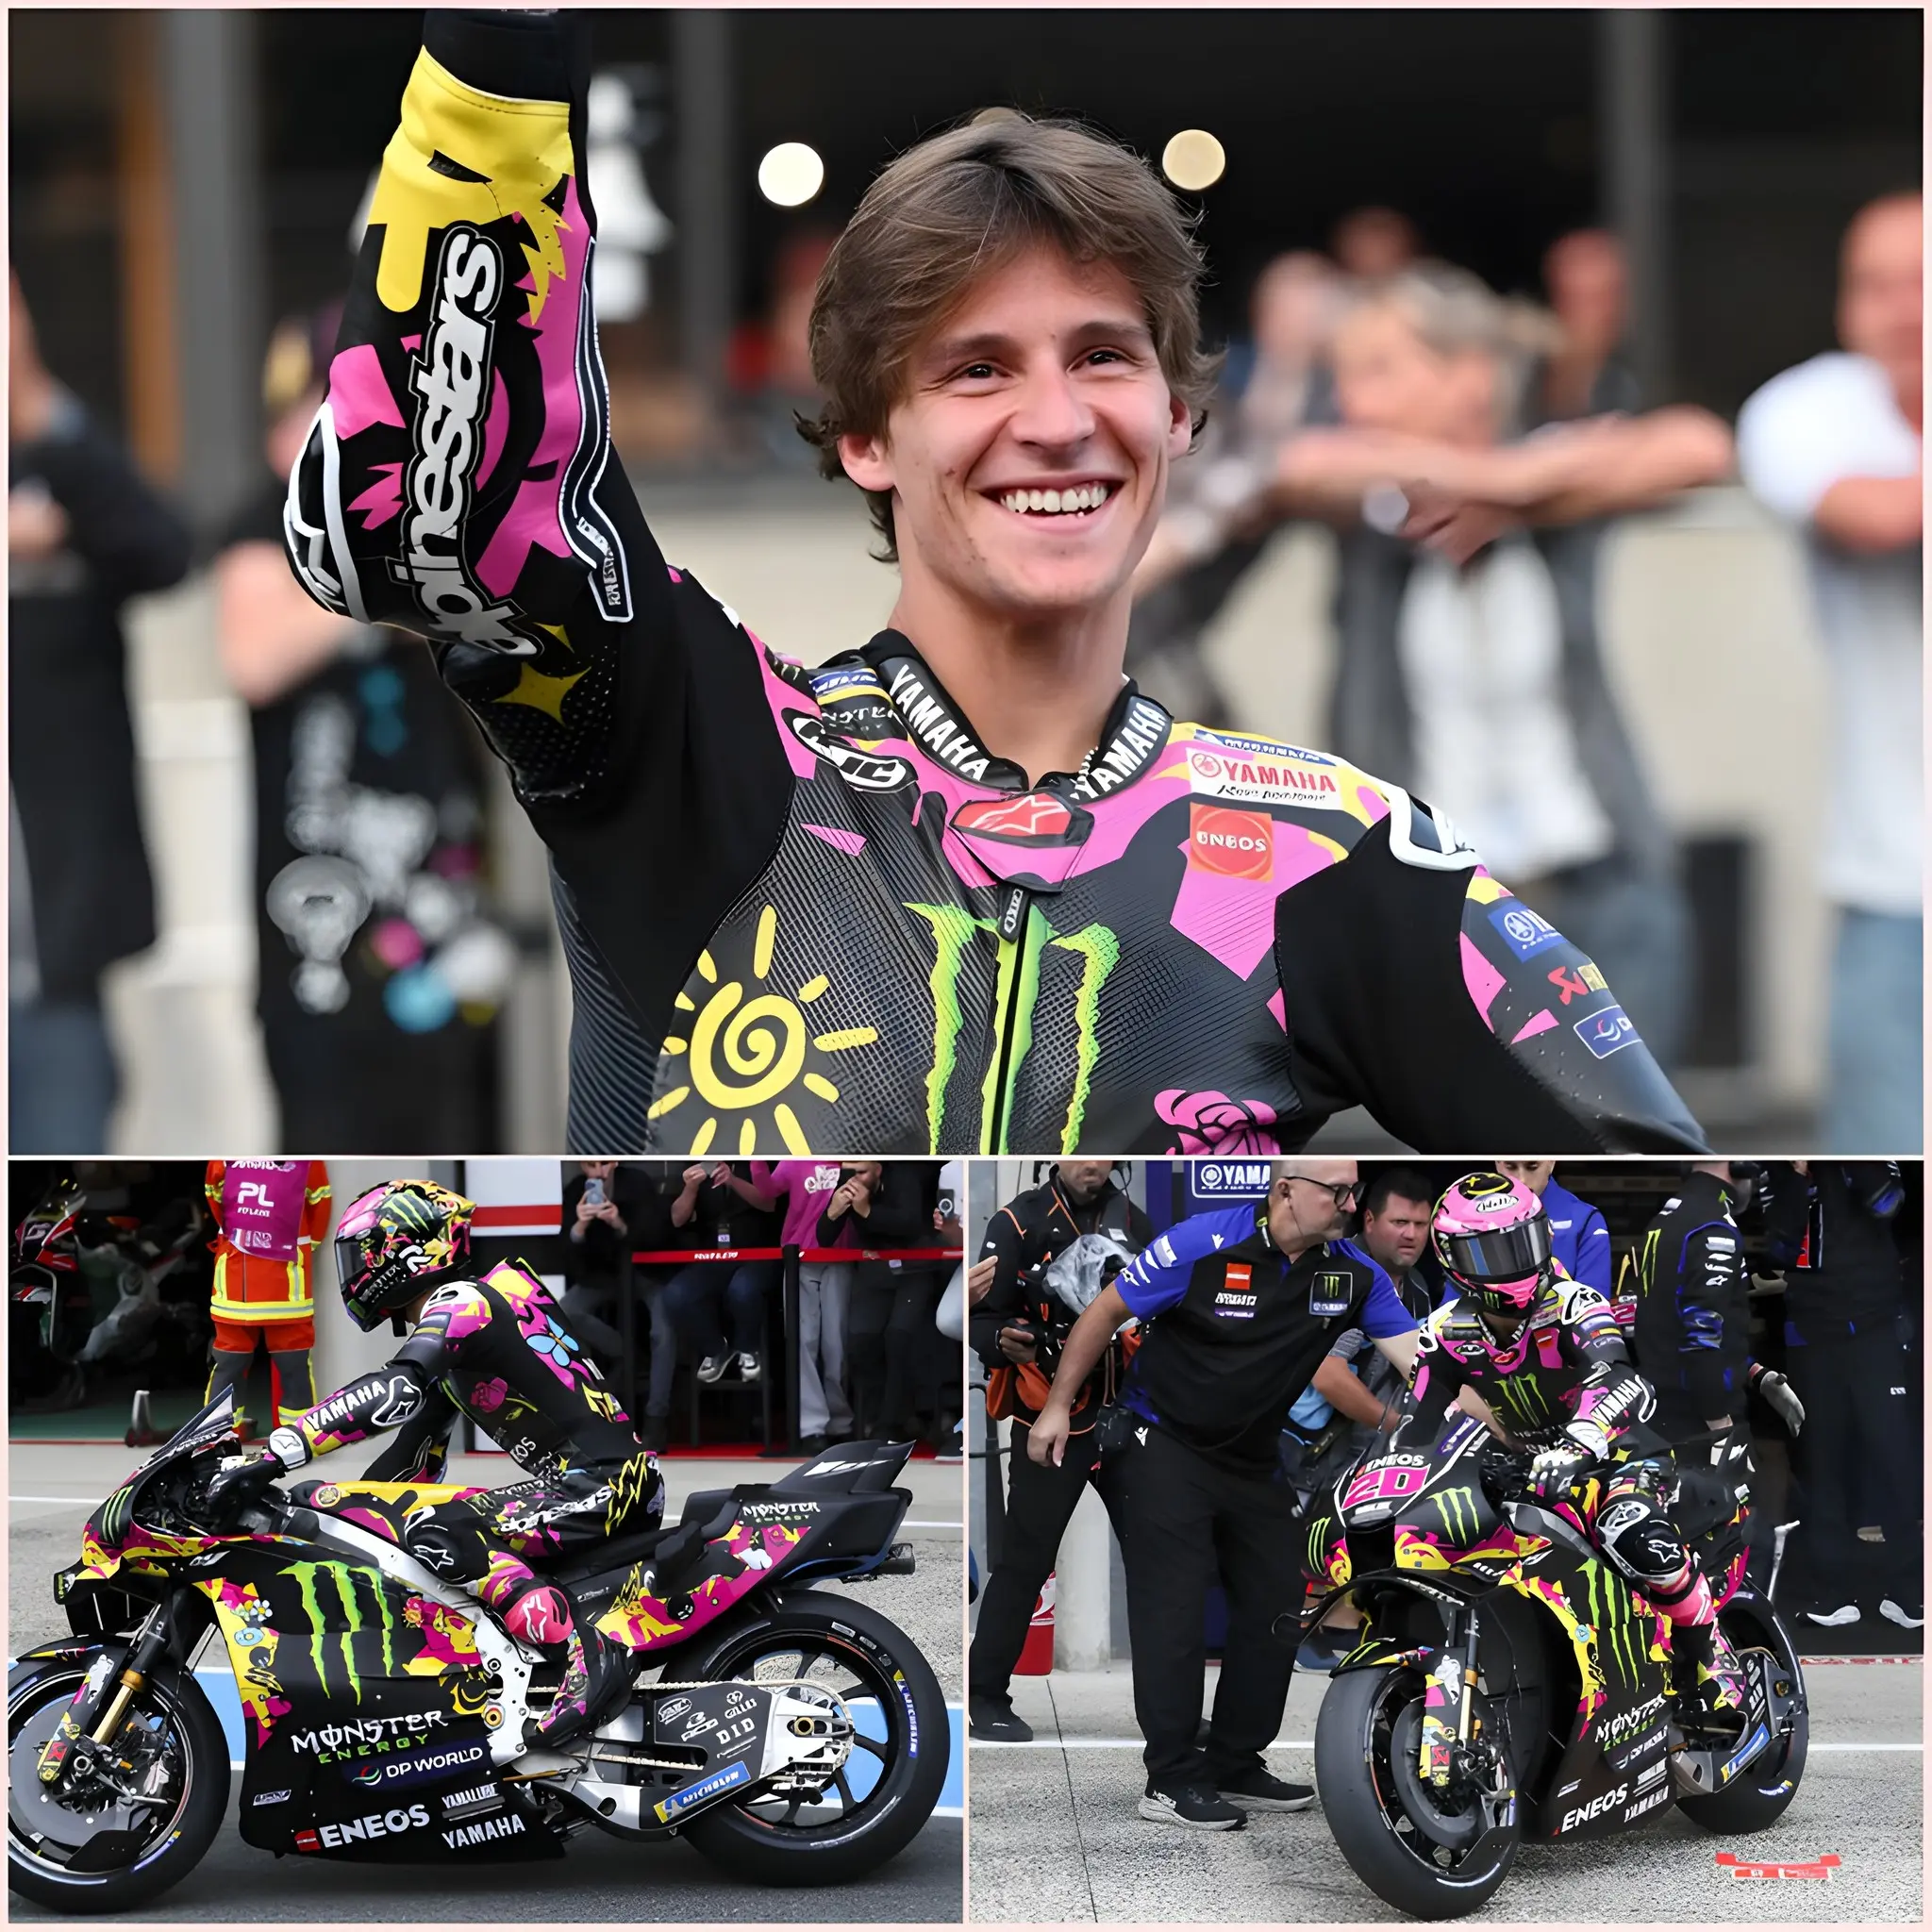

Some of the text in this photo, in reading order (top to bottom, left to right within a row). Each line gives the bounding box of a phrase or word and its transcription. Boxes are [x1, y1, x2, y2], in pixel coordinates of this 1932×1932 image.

[890, 664, 991, 782] YAMAHA
[1074, 702, 1168, 799] YAMAHA
[1223, 759, 1337, 792] YAMAHA
[237, 1181, 275, 1208] PL
[306, 1380, 386, 1429] YAMAHA
[1341, 1464, 1432, 1512] 20
[291, 1710, 449, 1755] MONSTER
[318, 1734, 428, 1764] ENERGY
[386, 1747, 483, 1778] DP WORLD
[319, 1804, 430, 1848] ENEOS
[1561, 1783, 1629, 1835] ENEOS
[441, 1814, 526, 1849] YAMAHA
